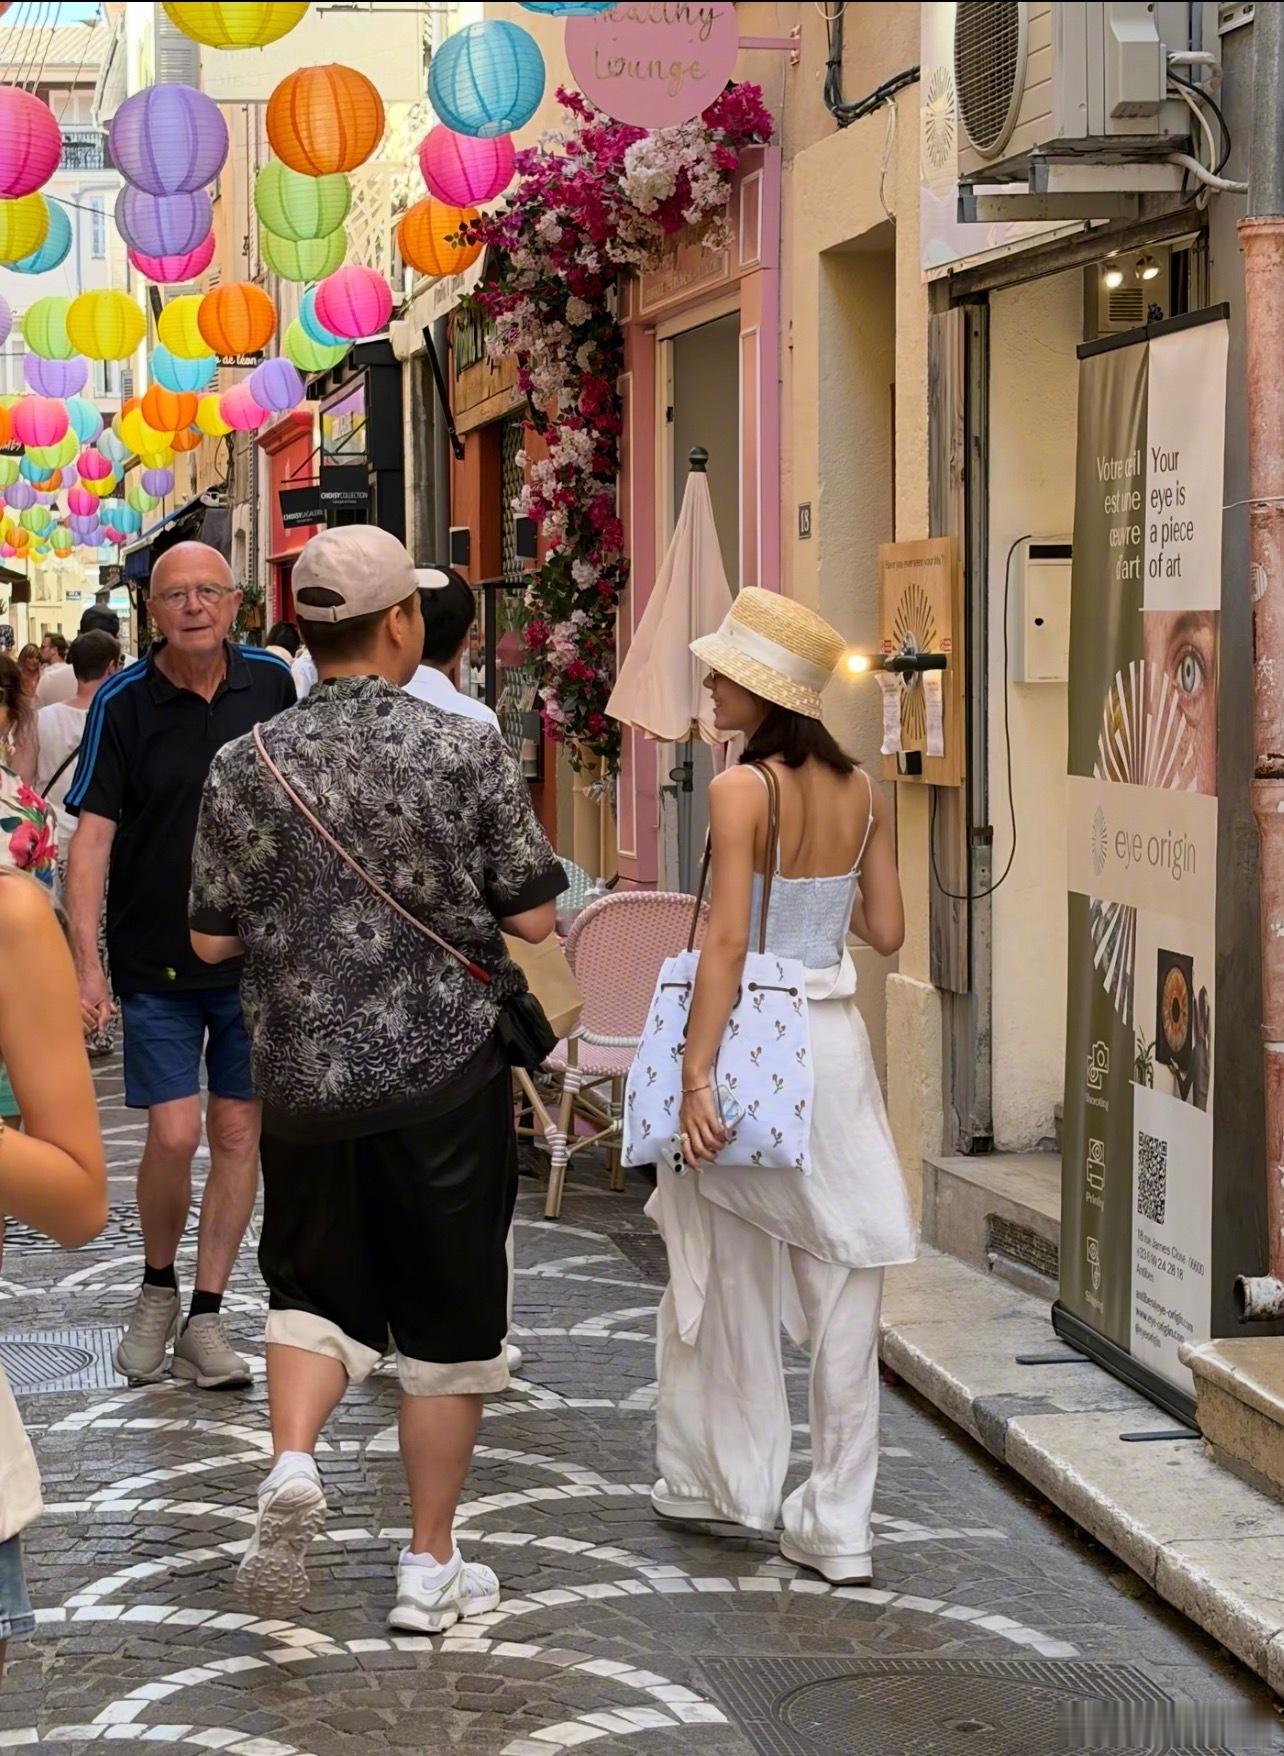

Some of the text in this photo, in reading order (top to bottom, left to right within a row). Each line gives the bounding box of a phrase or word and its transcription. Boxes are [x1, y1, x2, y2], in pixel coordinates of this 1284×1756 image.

[594, 3, 724, 42] ealthy
[594, 49, 707, 97] Lounge
[1096, 456, 1123, 482] Votre
[1151, 446, 1180, 473] Your
[1104, 489, 1141, 515] est une
[1150, 480, 1186, 514] eye is
[801, 509, 810, 532] 18
[1149, 516, 1194, 549] a piece
[1109, 524, 1141, 548] œuvre
[1149, 552, 1182, 578] of art
[1114, 829, 1196, 881] eye origin
